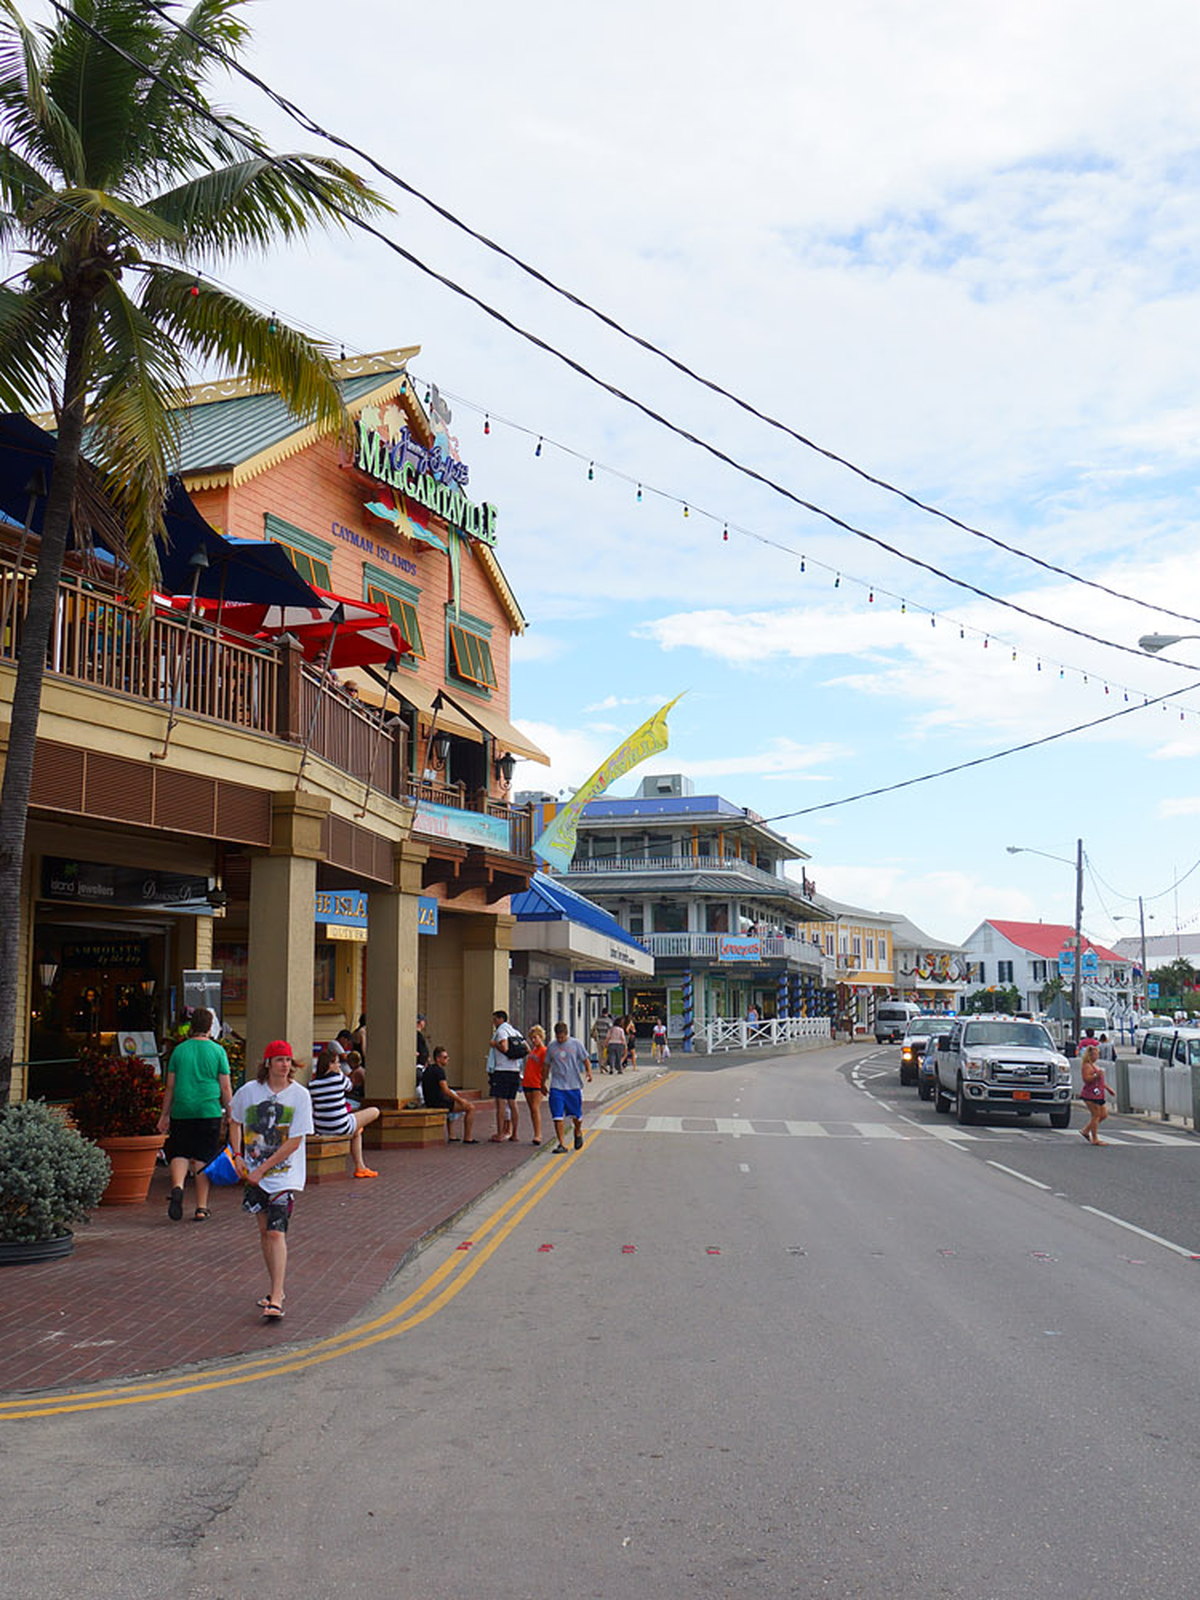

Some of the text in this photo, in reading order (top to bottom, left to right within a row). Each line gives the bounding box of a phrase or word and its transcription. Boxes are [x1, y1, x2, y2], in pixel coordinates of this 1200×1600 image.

[332, 522, 417, 576] CAYMAN ISLANDS
[316, 894, 331, 913] HE
[335, 896, 368, 917] ISLA
